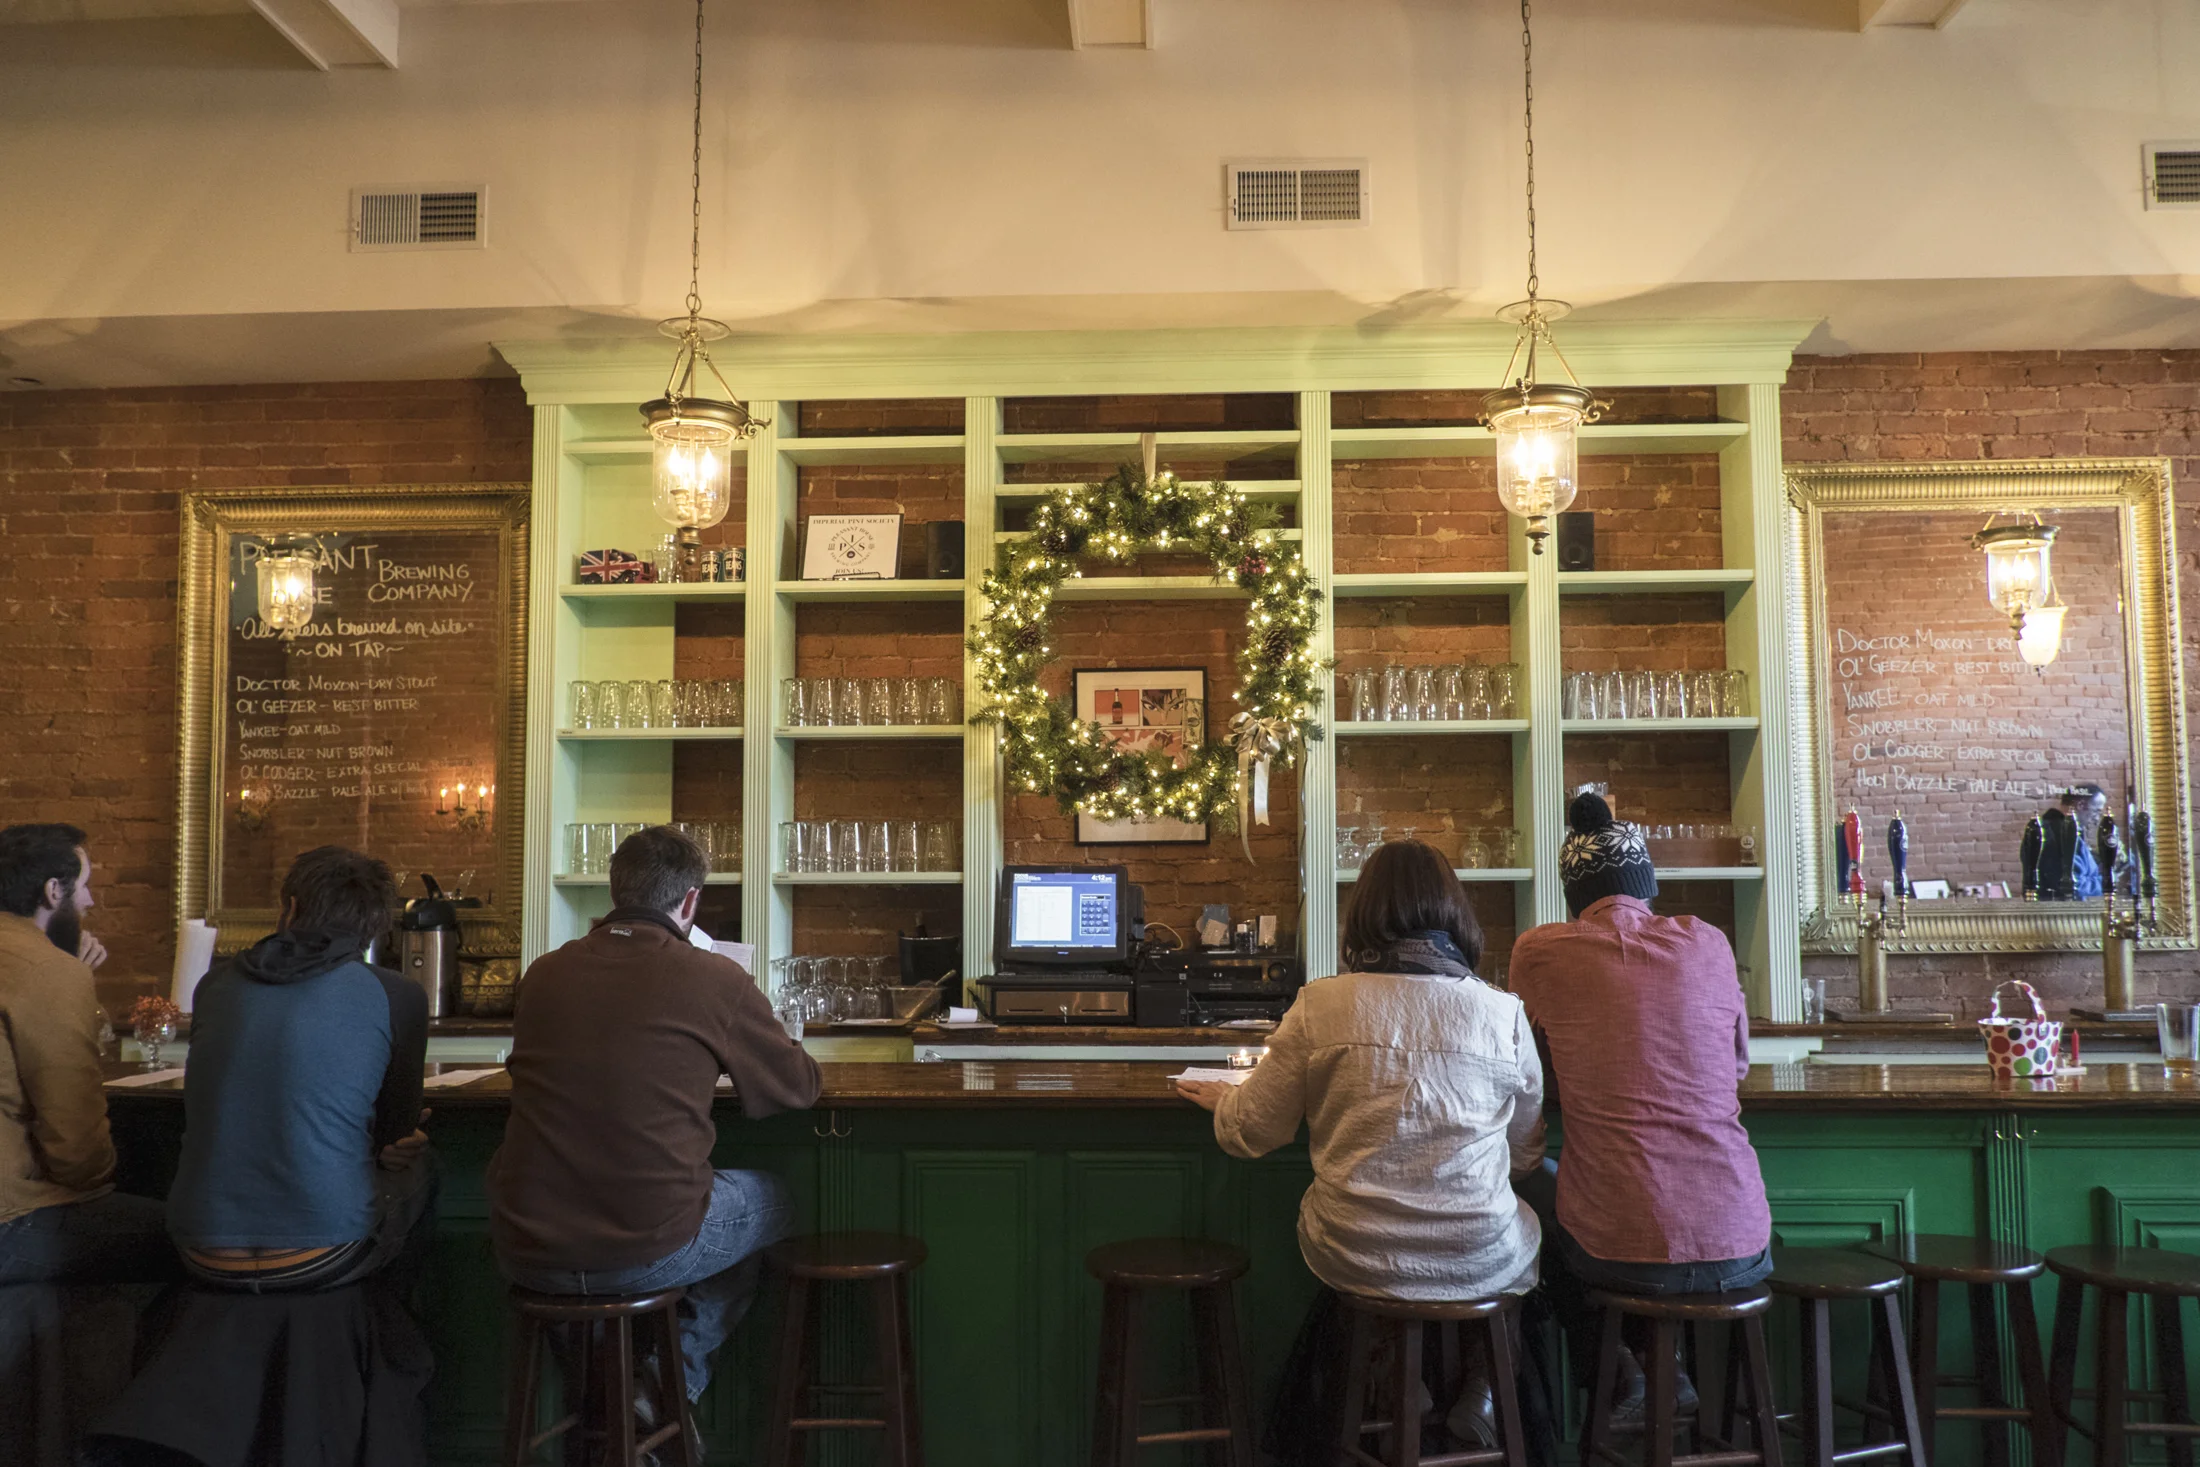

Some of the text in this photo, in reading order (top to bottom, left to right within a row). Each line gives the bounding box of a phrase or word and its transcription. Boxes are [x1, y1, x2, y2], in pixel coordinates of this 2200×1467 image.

[831, 526, 858, 542] PLEASANT
[839, 542, 866, 551] P S
[379, 560, 470, 582] BREWING
[368, 581, 474, 603] COMPANY
[279, 621, 334, 639] eers
[337, 617, 402, 636] brewed
[404, 622, 429, 639] on
[429, 617, 466, 635] site
[315, 641, 342, 657] ON
[1837, 628, 1910, 653] DOCTOR
[1915, 628, 1972, 650] MOXON
[1987, 637, 2014, 651] DRY
[1869, 654, 1938, 675] GEEZER
[1954, 661, 1992, 675] BEST
[236, 675, 301, 693] DOCTOR
[308, 674, 360, 692] MOXON
[368, 678, 394, 692] DRY
[262, 699, 318, 714] GEEZER
[333, 699, 369, 712] BEST
[374, 698, 420, 711] BITTER
[1842, 682, 1900, 710] YANKEE
[1914, 692, 1950, 706] OAT
[1957, 694, 1996, 708] MILD
[238, 719, 280, 740] YANKEE
[288, 723, 310, 735] OAT
[1847, 713, 1937, 738] SNOBBLER
[1951, 718, 1980, 734] NUT
[1988, 720, 2043, 738] BROWN
[239, 745, 306, 761] SNOBBLER
[316, 746, 344, 760] NUT
[348, 744, 395, 759] BROWN
[1884, 739, 1945, 761] CODGER
[1957, 746, 1997, 760] EXTRA
[262, 765, 317, 782] CODGER
[326, 765, 369, 779] EXTRA
[1856, 767, 1887, 789] HOLY
[1892, 764, 1958, 791] BAZZLE
[1969, 779, 1999, 794] PALE
[2003, 778, 2032, 796] ALE
[273, 783, 320, 800] BAZZLE
